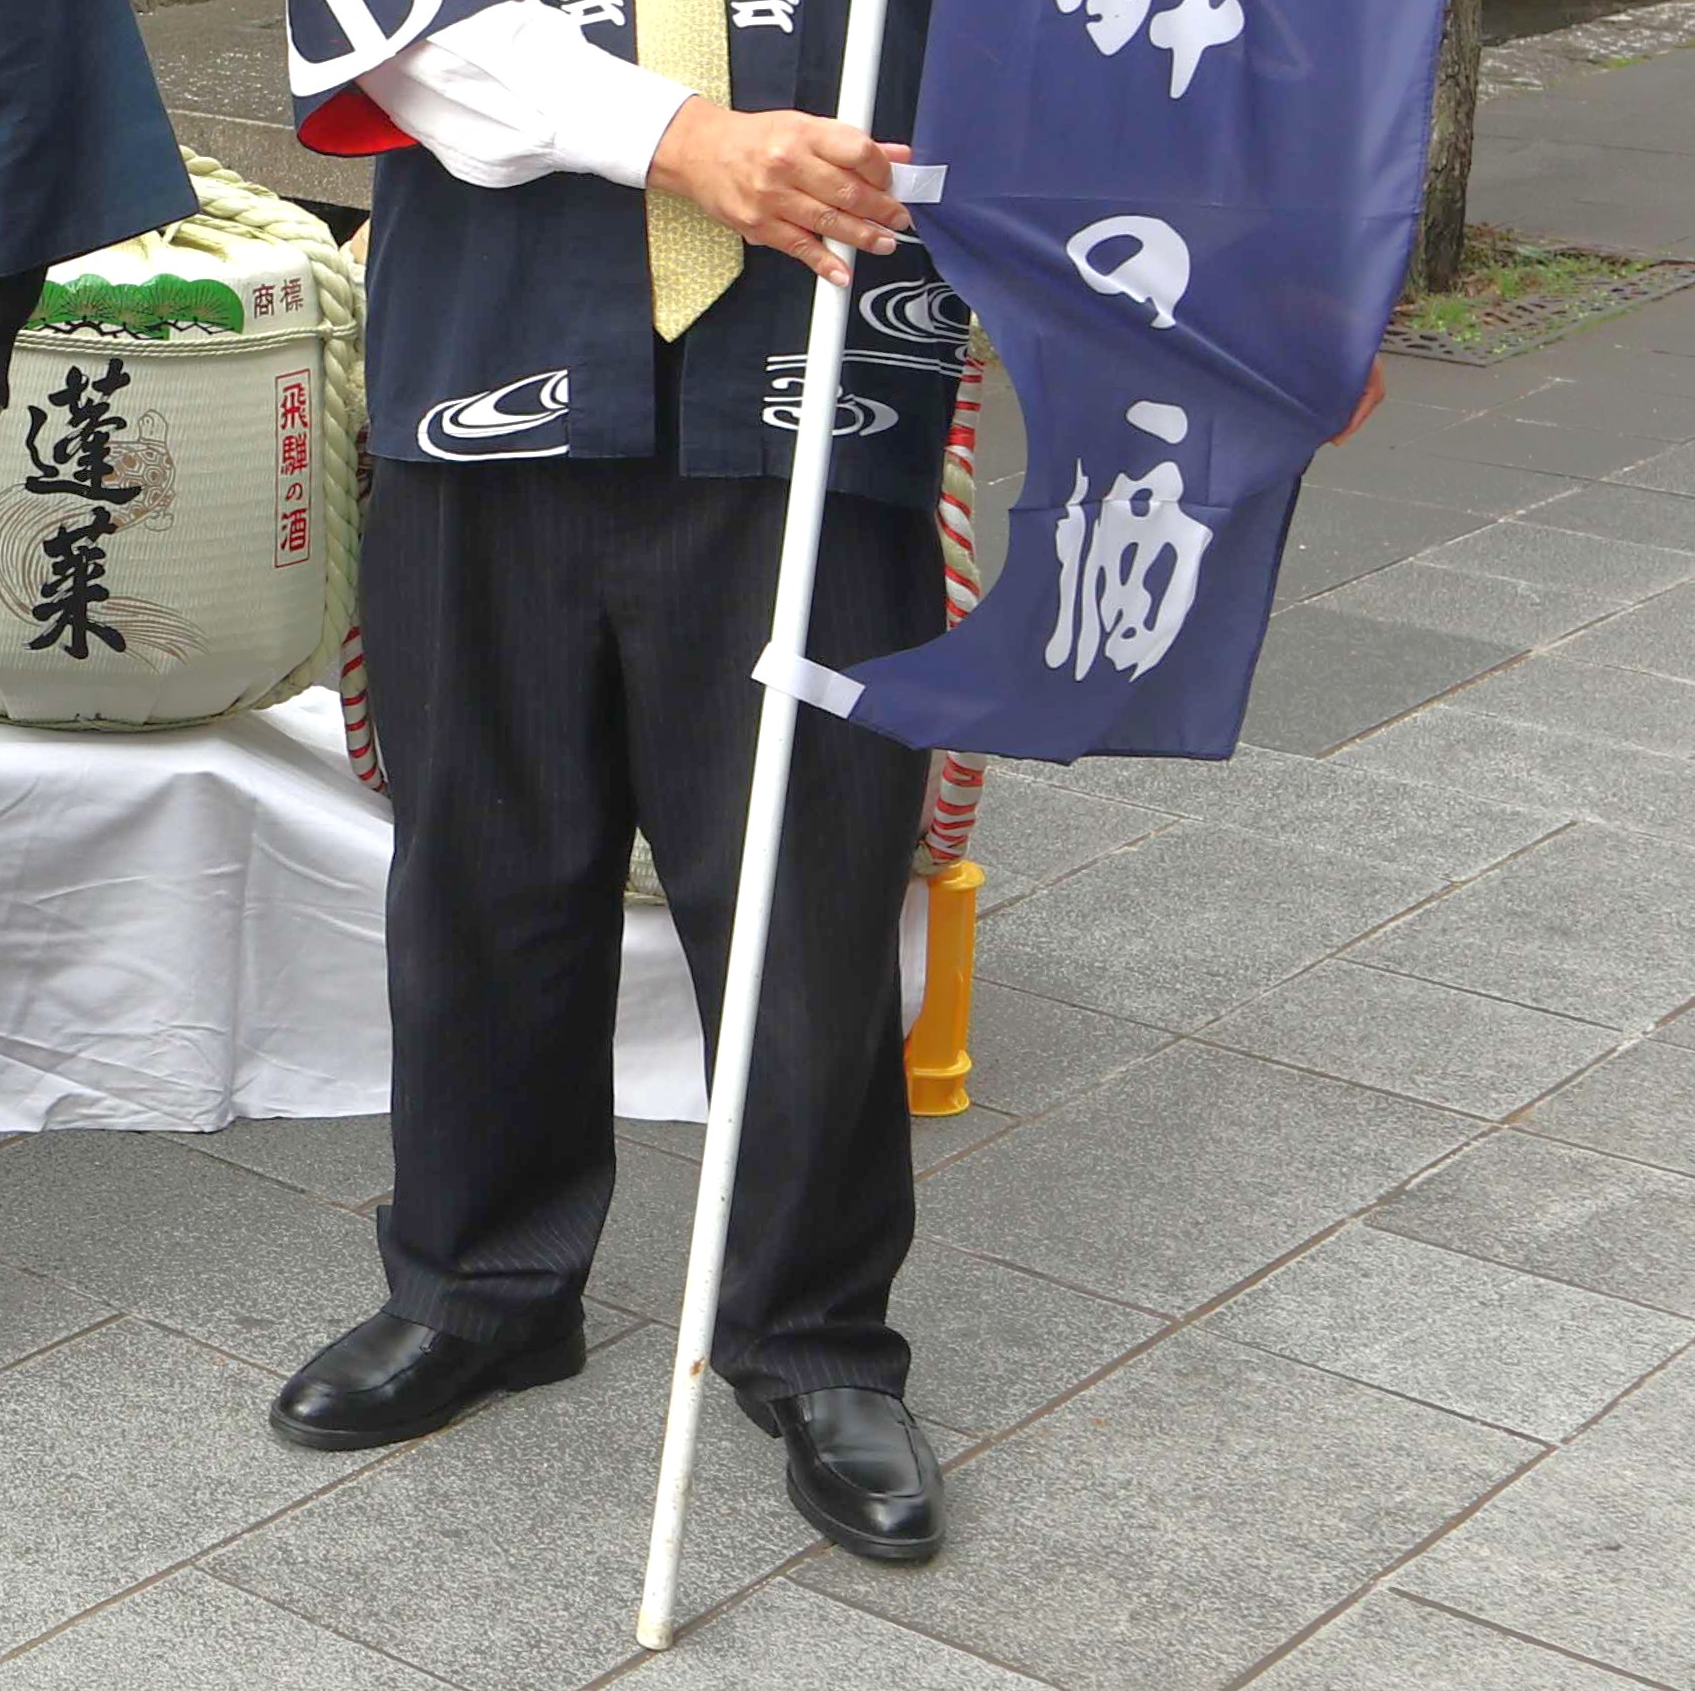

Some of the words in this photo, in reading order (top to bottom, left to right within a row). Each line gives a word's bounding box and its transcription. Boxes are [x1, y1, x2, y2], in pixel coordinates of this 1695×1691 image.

[252, 277, 305, 320] 商標
[278, 383, 310, 555] 飛騨の酒
